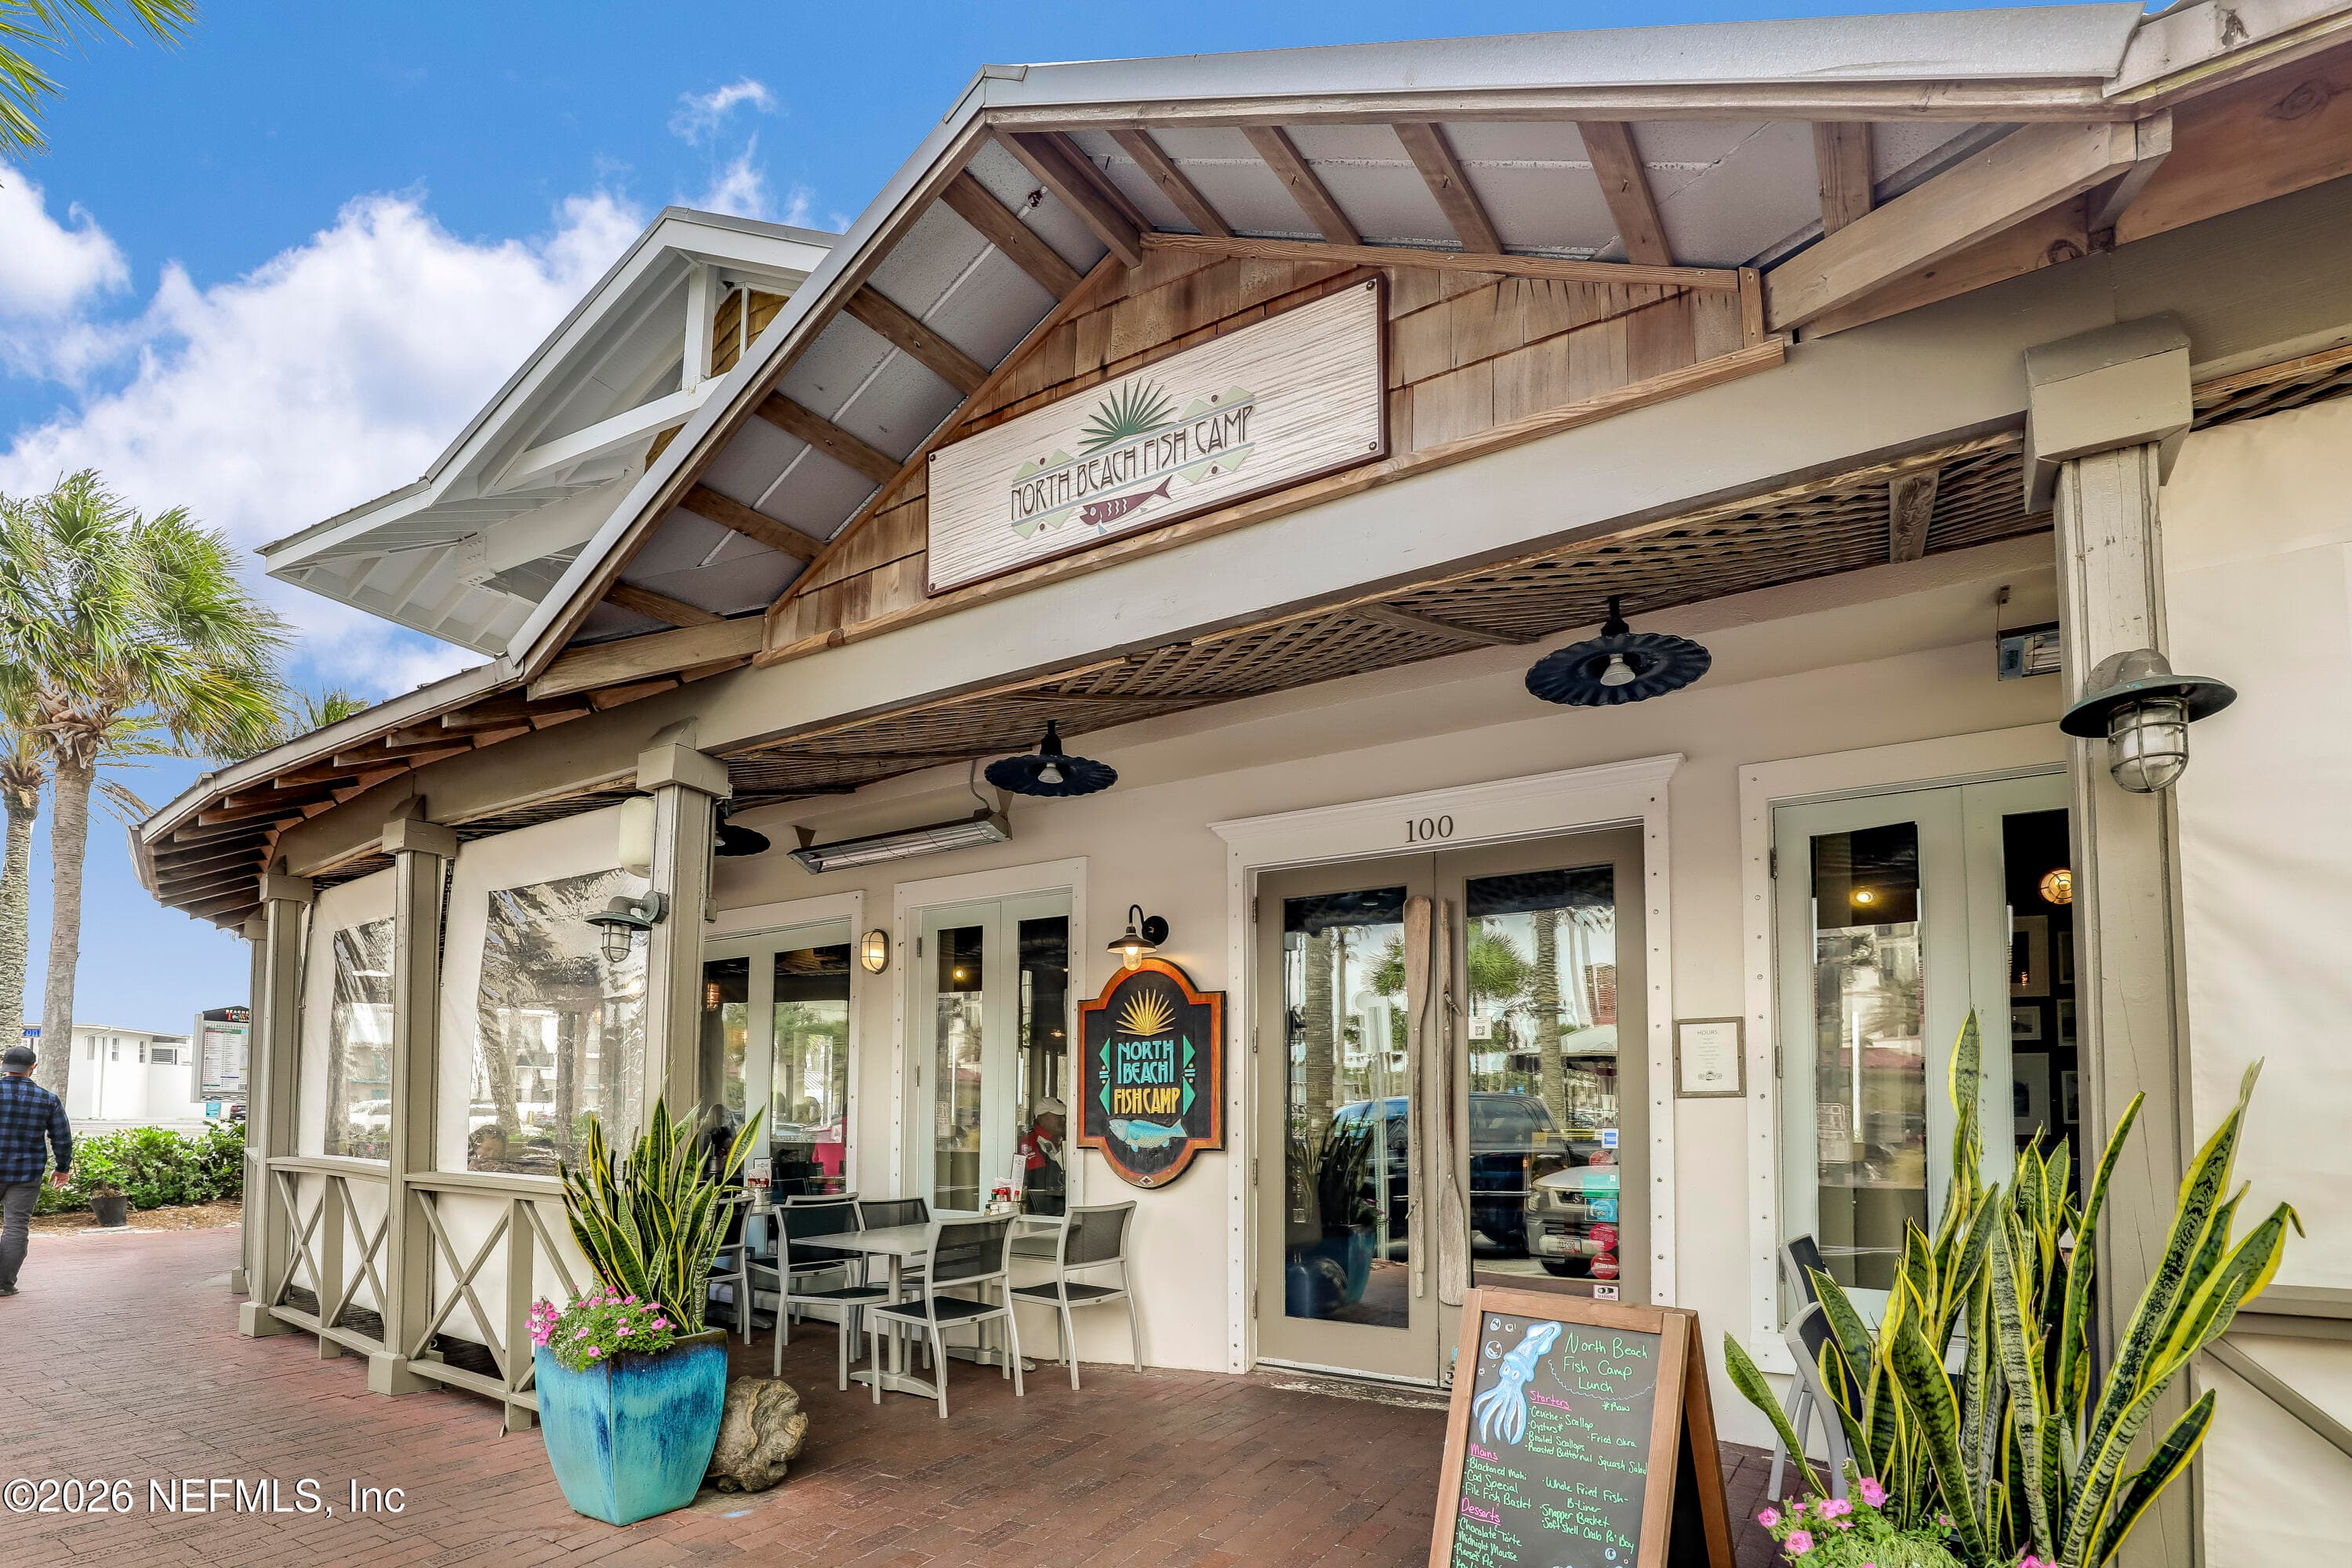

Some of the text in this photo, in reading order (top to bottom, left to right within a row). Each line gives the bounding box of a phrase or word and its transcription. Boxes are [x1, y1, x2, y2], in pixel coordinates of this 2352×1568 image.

[1011, 405, 1253, 520] NORTH BEACH FISH CAMP
[1406, 815, 1453, 843] 100
[1123, 1062, 1168, 1084] BEACH
[1114, 1087, 1181, 1114] FISH CAMP
[1564, 1332, 1648, 1359] North Beach
[1563, 1356, 1632, 1381] Fish Camp
[1578, 1377, 1613, 1393] Lunch
[1530, 1390, 1570, 1409] Starters
[1565, 1414, 1594, 1431] Scallop
[1555, 1436, 1585, 1453] Scallops
[1591, 1433, 1611, 1444] Fried
[1470, 1443, 1498, 1460] Mains
[1556, 1448, 1593, 1463] Butternut
[1597, 1456, 1625, 1471] Squash
[1469, 1457, 1506, 1476] Blackened
[1467, 1469, 1519, 1494] Cod Special
[1545, 1476, 1573, 1492] Whole
[1576, 1483, 1598, 1498] Fried
[1483, 1487, 1501, 1503] Fish
[1503, 1492, 1532, 1508] Basket
[1461, 1497, 1501, 1523] Desserts
[1541, 1504, 1610, 1527] Snapper Basket
[1459, 1517, 1497, 1539] Chocolate
[1458, 1530, 1519, 1561] Midnight Mousse
[1482, 1553, 1494, 1568] Pie
